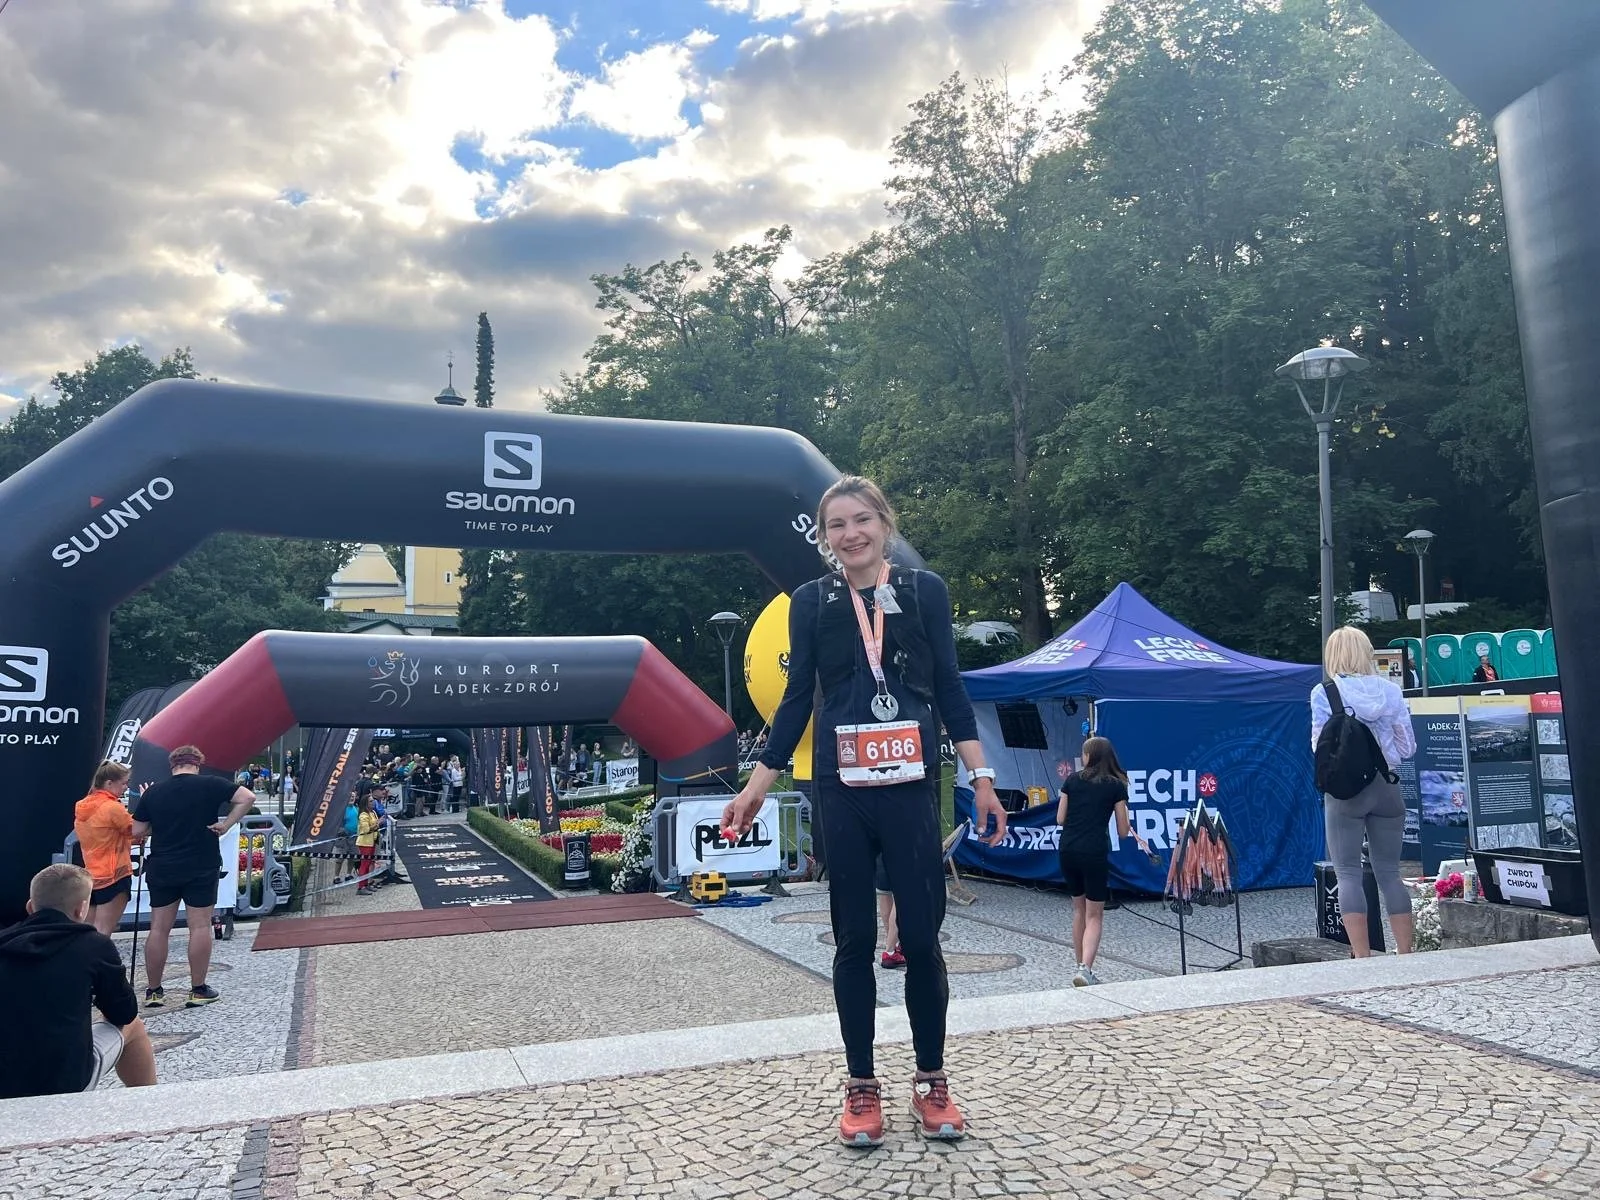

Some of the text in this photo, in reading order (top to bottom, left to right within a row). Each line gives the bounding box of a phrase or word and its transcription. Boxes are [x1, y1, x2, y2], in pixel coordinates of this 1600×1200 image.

[51, 476, 174, 568] SUUNTO
[465, 520, 554, 533] TIME TO PLAY
[1134, 636, 1197, 650] LECH
[1146, 649, 1232, 664] FREE
[434, 663, 560, 676] KURORT
[433, 679, 560, 697] LĄDEK-ZDRÓJ
[0, 705, 79, 724] omon
[24, 735, 60, 745] PLAY
[109, 717, 142, 768] PETZL
[866, 737, 916, 760] 6186
[611, 765, 638, 779] Starop
[310, 727, 359, 837] GOLDENTRAILSER
[1127, 768, 1196, 804] ECH
[1507, 868, 1533, 878] ZWROT
[1507, 878, 1538, 889] CHIPÓW
[1325, 901, 1341, 913] FE
